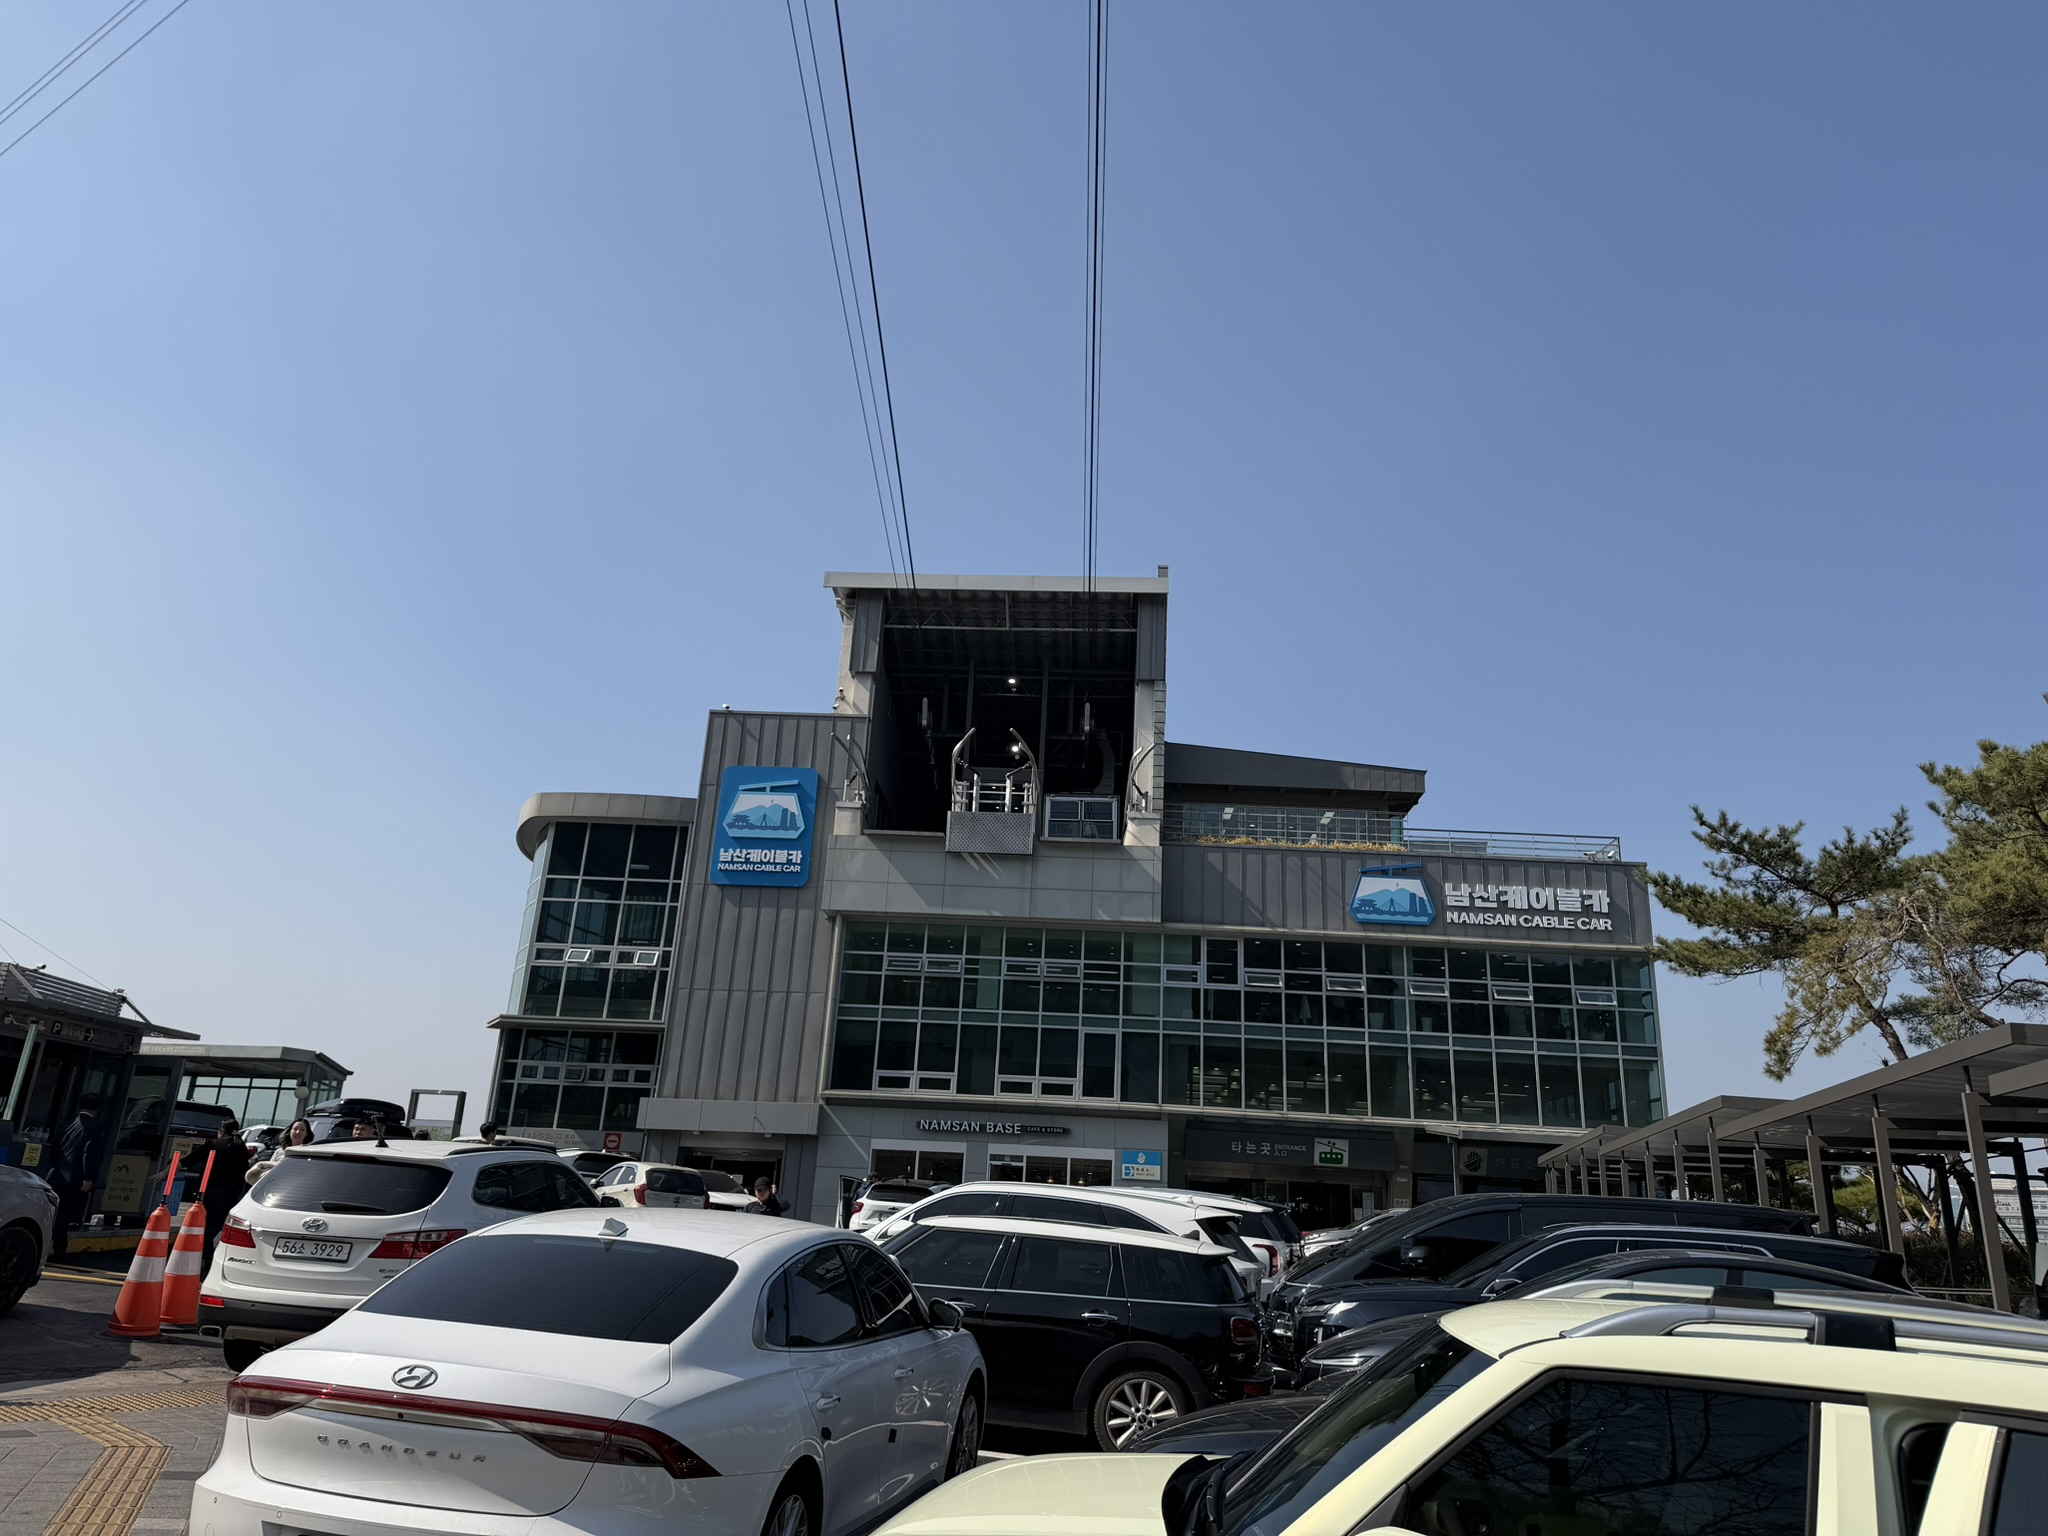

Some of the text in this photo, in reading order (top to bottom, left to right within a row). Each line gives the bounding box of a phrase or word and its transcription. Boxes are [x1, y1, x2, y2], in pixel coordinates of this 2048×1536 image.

[719, 848, 802, 864] 남산케이블카
[718, 863, 801, 873] NAMSAN CABLE CAR
[1445, 882, 1610, 913] 남산케이블카
[1446, 911, 1613, 931] NAMSAN CABLE CAR
[53, 1023, 85, 1039] Parking
[920, 1119, 980, 1133] NAMSAN
[986, 1122, 1022, 1134] BASE
[1274, 1144, 1307, 1152] ENTRANCE
[281, 1241, 344, 1257] 56소 3929
[317, 1434, 486, 1462] GRANDEUR
